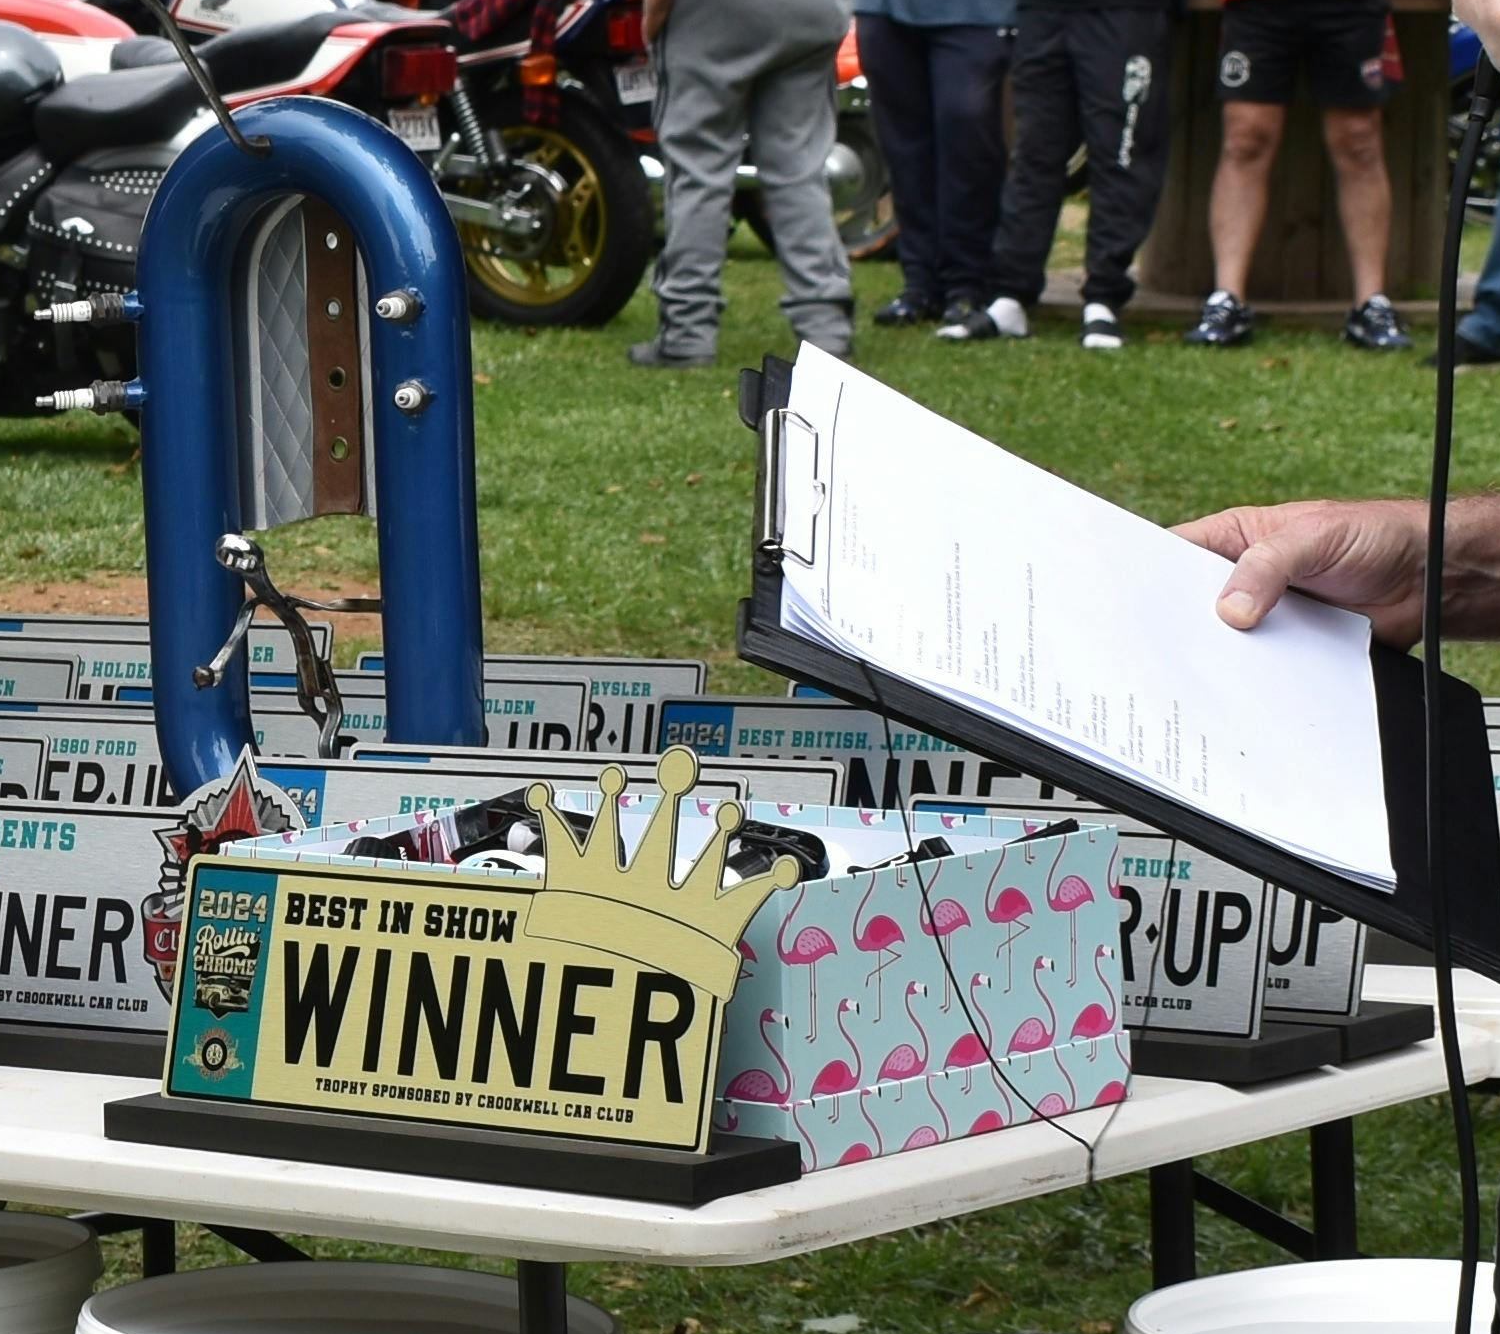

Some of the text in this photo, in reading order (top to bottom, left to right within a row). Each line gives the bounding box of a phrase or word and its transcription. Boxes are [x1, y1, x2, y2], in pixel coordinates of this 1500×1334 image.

[92, 661, 152, 679] HOLDE
[666, 721, 726, 747] 2024
[738, 729, 783, 747] BEST
[52, 738, 137, 756] 1980 FORD
[1122, 857, 1191, 880] TRUCK
[198, 889, 268, 923] 2024
[285, 892, 517, 944] BEST IN SHOW
[194, 924, 261, 956] Rollin'
[194, 955, 257, 976] CHROME
[16, 991, 85, 1007] CROOKWELL
[89, 996, 112, 1010] CAR
[116, 999, 148, 1012] CLUB
[1135, 996, 1192, 1010] CAR CLUB
[284, 940, 695, 1104] WINNER
[316, 1077, 634, 1124] TROPHY SPONSORED BY CROOKWELL CAR CLUB
